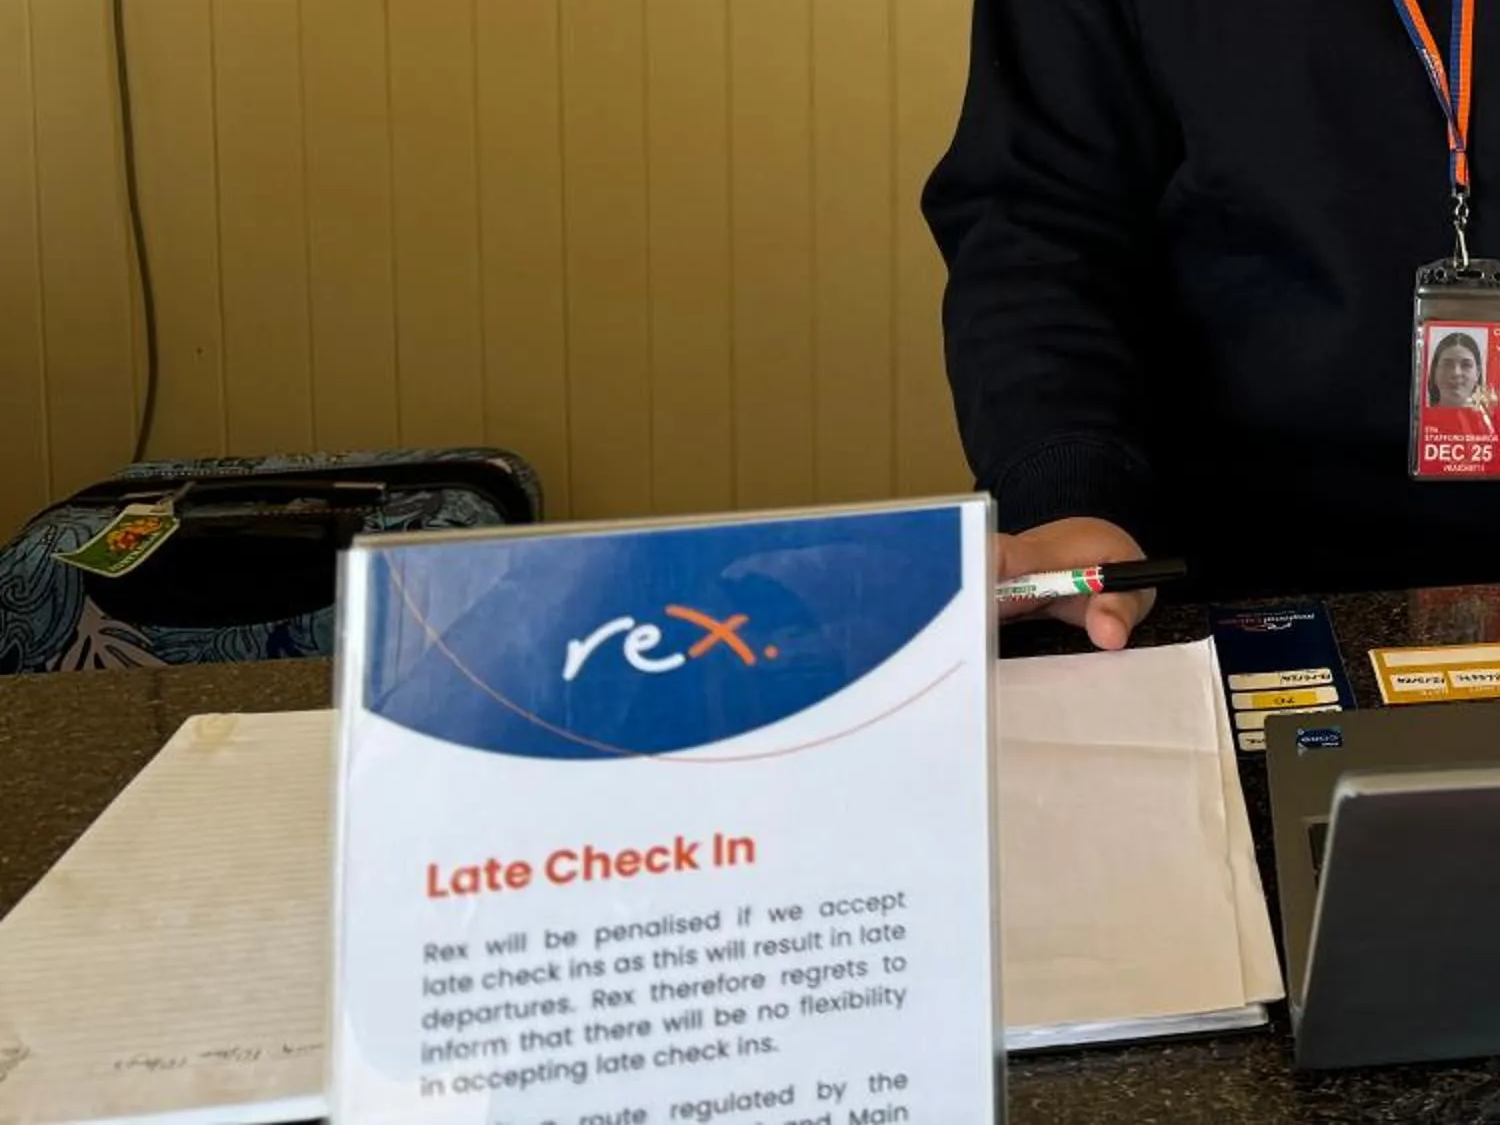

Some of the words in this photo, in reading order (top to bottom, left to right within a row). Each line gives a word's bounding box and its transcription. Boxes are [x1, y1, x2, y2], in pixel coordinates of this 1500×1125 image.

[1424, 444, 1465, 461] DEC
[1471, 444, 1493, 462] 25
[427, 858, 532, 898] Late
[545, 836, 699, 884] Check
[713, 832, 756, 866] In
[423, 973, 474, 996] late
[482, 962, 561, 990] check
[569, 958, 606, 979] ins
[614, 954, 644, 974] as
[653, 947, 698, 969] this
[706, 939, 745, 962] will
[754, 931, 823, 956] result
[830, 927, 851, 947] in
[860, 924, 906, 944] late
[424, 943, 468, 963] Rex
[486, 933, 527, 955] will
[545, 929, 577, 949] be
[595, 911, 720, 949] penalised
[737, 906, 752, 926] if
[768, 905, 803, 922] we
[819, 892, 906, 917] accept
[421, 997, 576, 1031] departures.
[592, 988, 635, 1009] Rex
[650, 972, 766, 1002] therefore
[781, 960, 868, 988] regrets
[883, 955, 907, 973] to
[421, 1037, 508, 1064] inform
[520, 1028, 573, 1052] that
[585, 1019, 652, 1043] there
[663, 1008, 703, 1033] will
[714, 1006, 747, 1027] be
[758, 1002, 789, 1021] no
[800, 985, 907, 1016] flexibility
[420, 1076, 445, 1097] in
[452, 1059, 588, 1094] accepting
[596, 1050, 646, 1074] late
[653, 1039, 729, 1068] check
[737, 1035, 780, 1057] ins.
[670, 1083, 795, 1124] regulated
[817, 1080, 847, 1104] by
[868, 1072, 908, 1093] the
